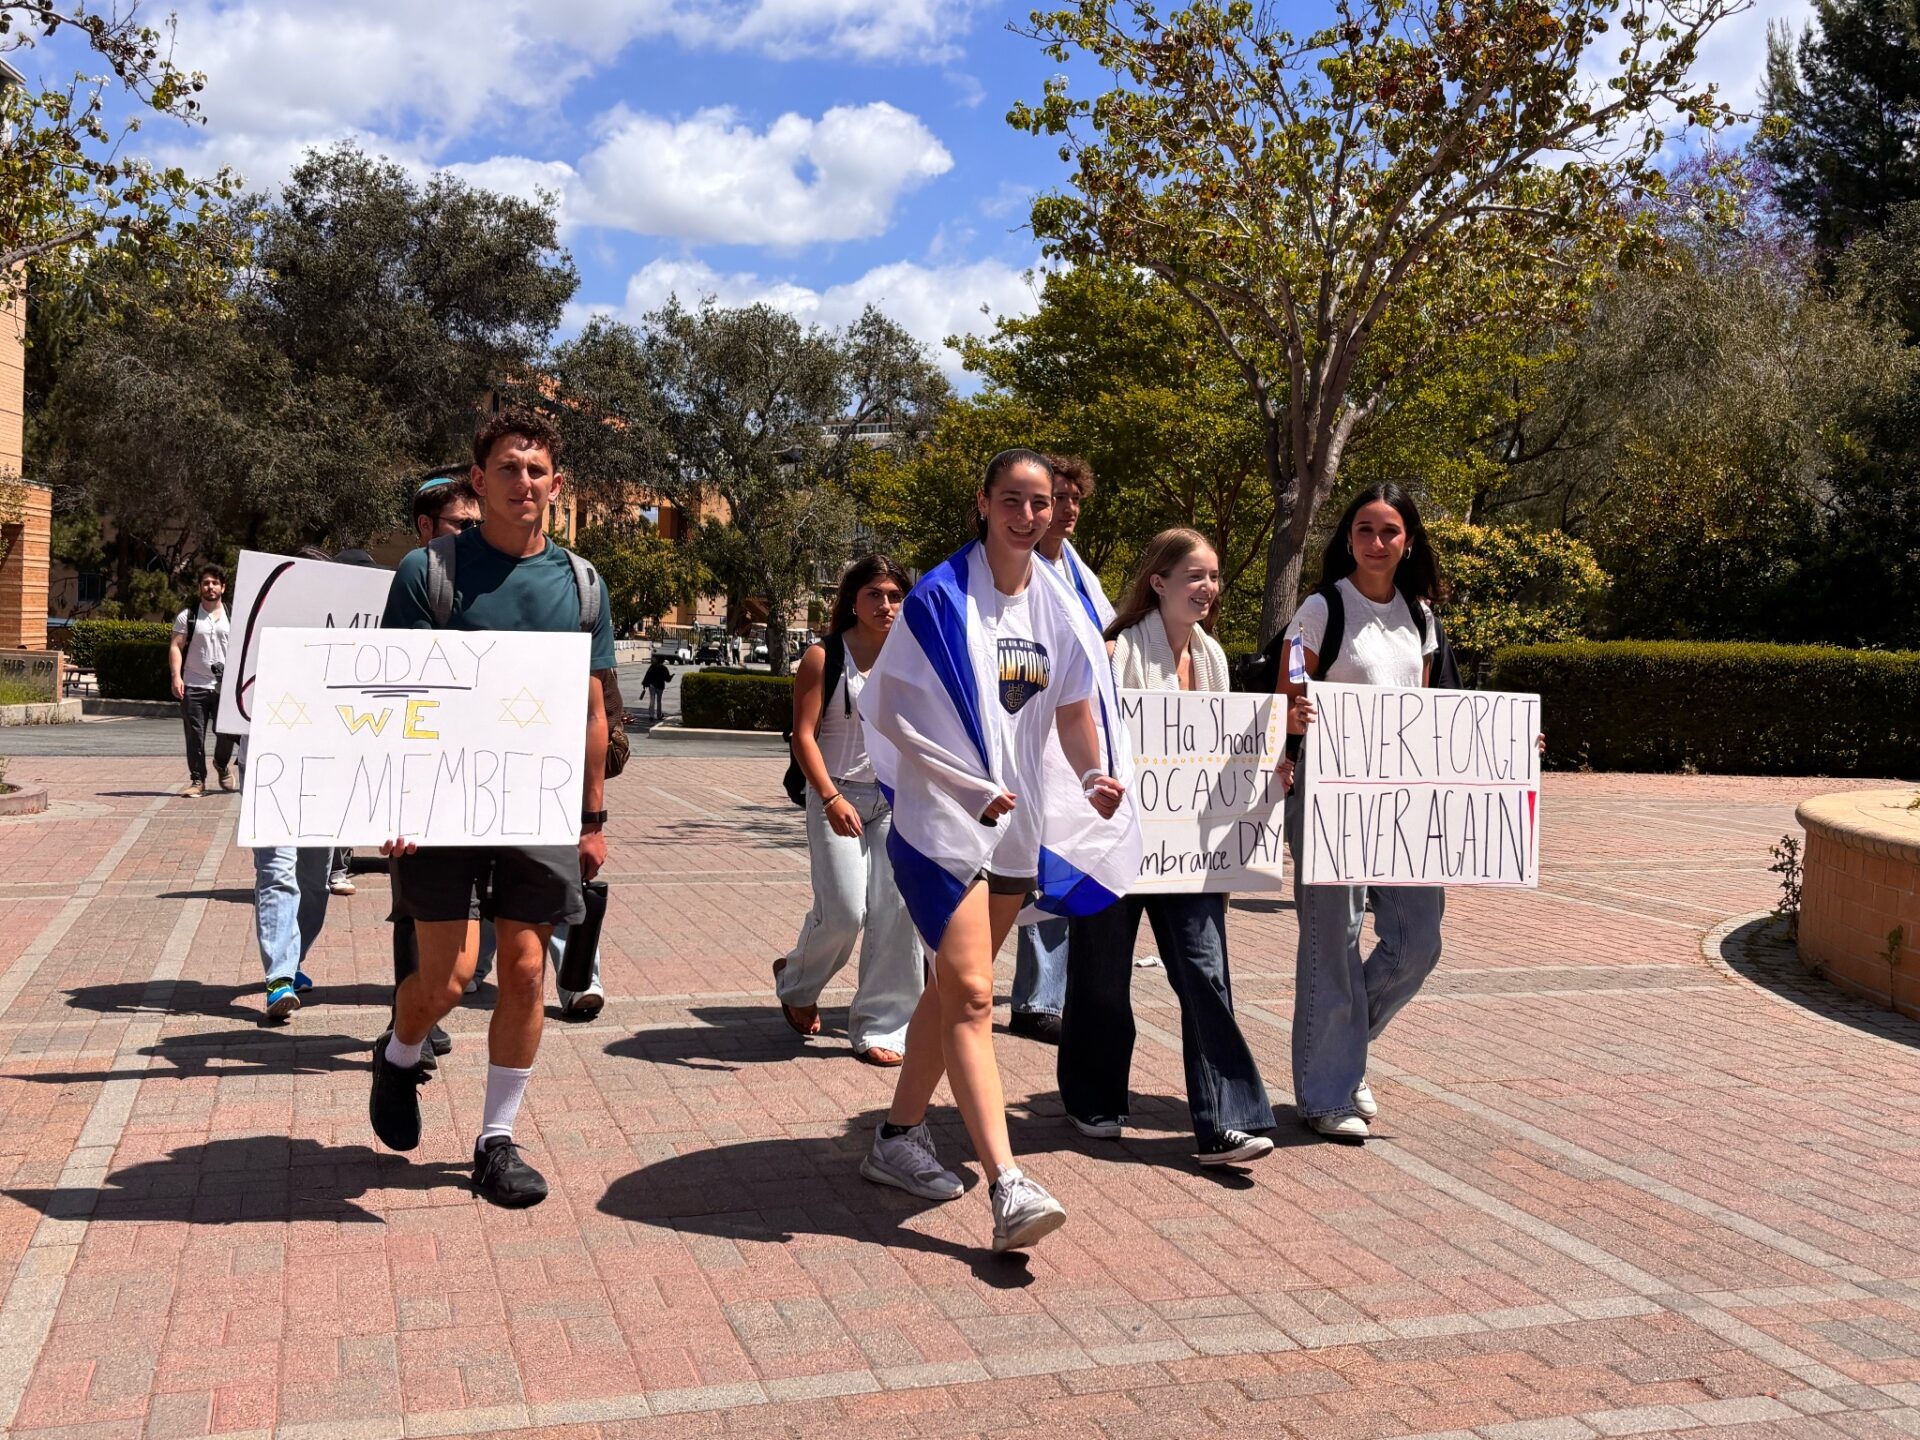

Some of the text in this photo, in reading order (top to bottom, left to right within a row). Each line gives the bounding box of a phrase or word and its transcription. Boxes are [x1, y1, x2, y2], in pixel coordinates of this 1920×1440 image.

[304, 638, 496, 687] TODAY
[998, 649, 1050, 688] AMPIONS
[335, 699, 441, 739] WE
[1121, 696, 1144, 755] M
[1315, 692, 1538, 780] NEVER FORGET
[252, 747, 574, 839] REMEMBER
[1140, 768, 1274, 812] OCAUST
[1137, 820, 1283, 876] mbrance DAY
[1312, 788, 1538, 882] NEVER AGAIN!
